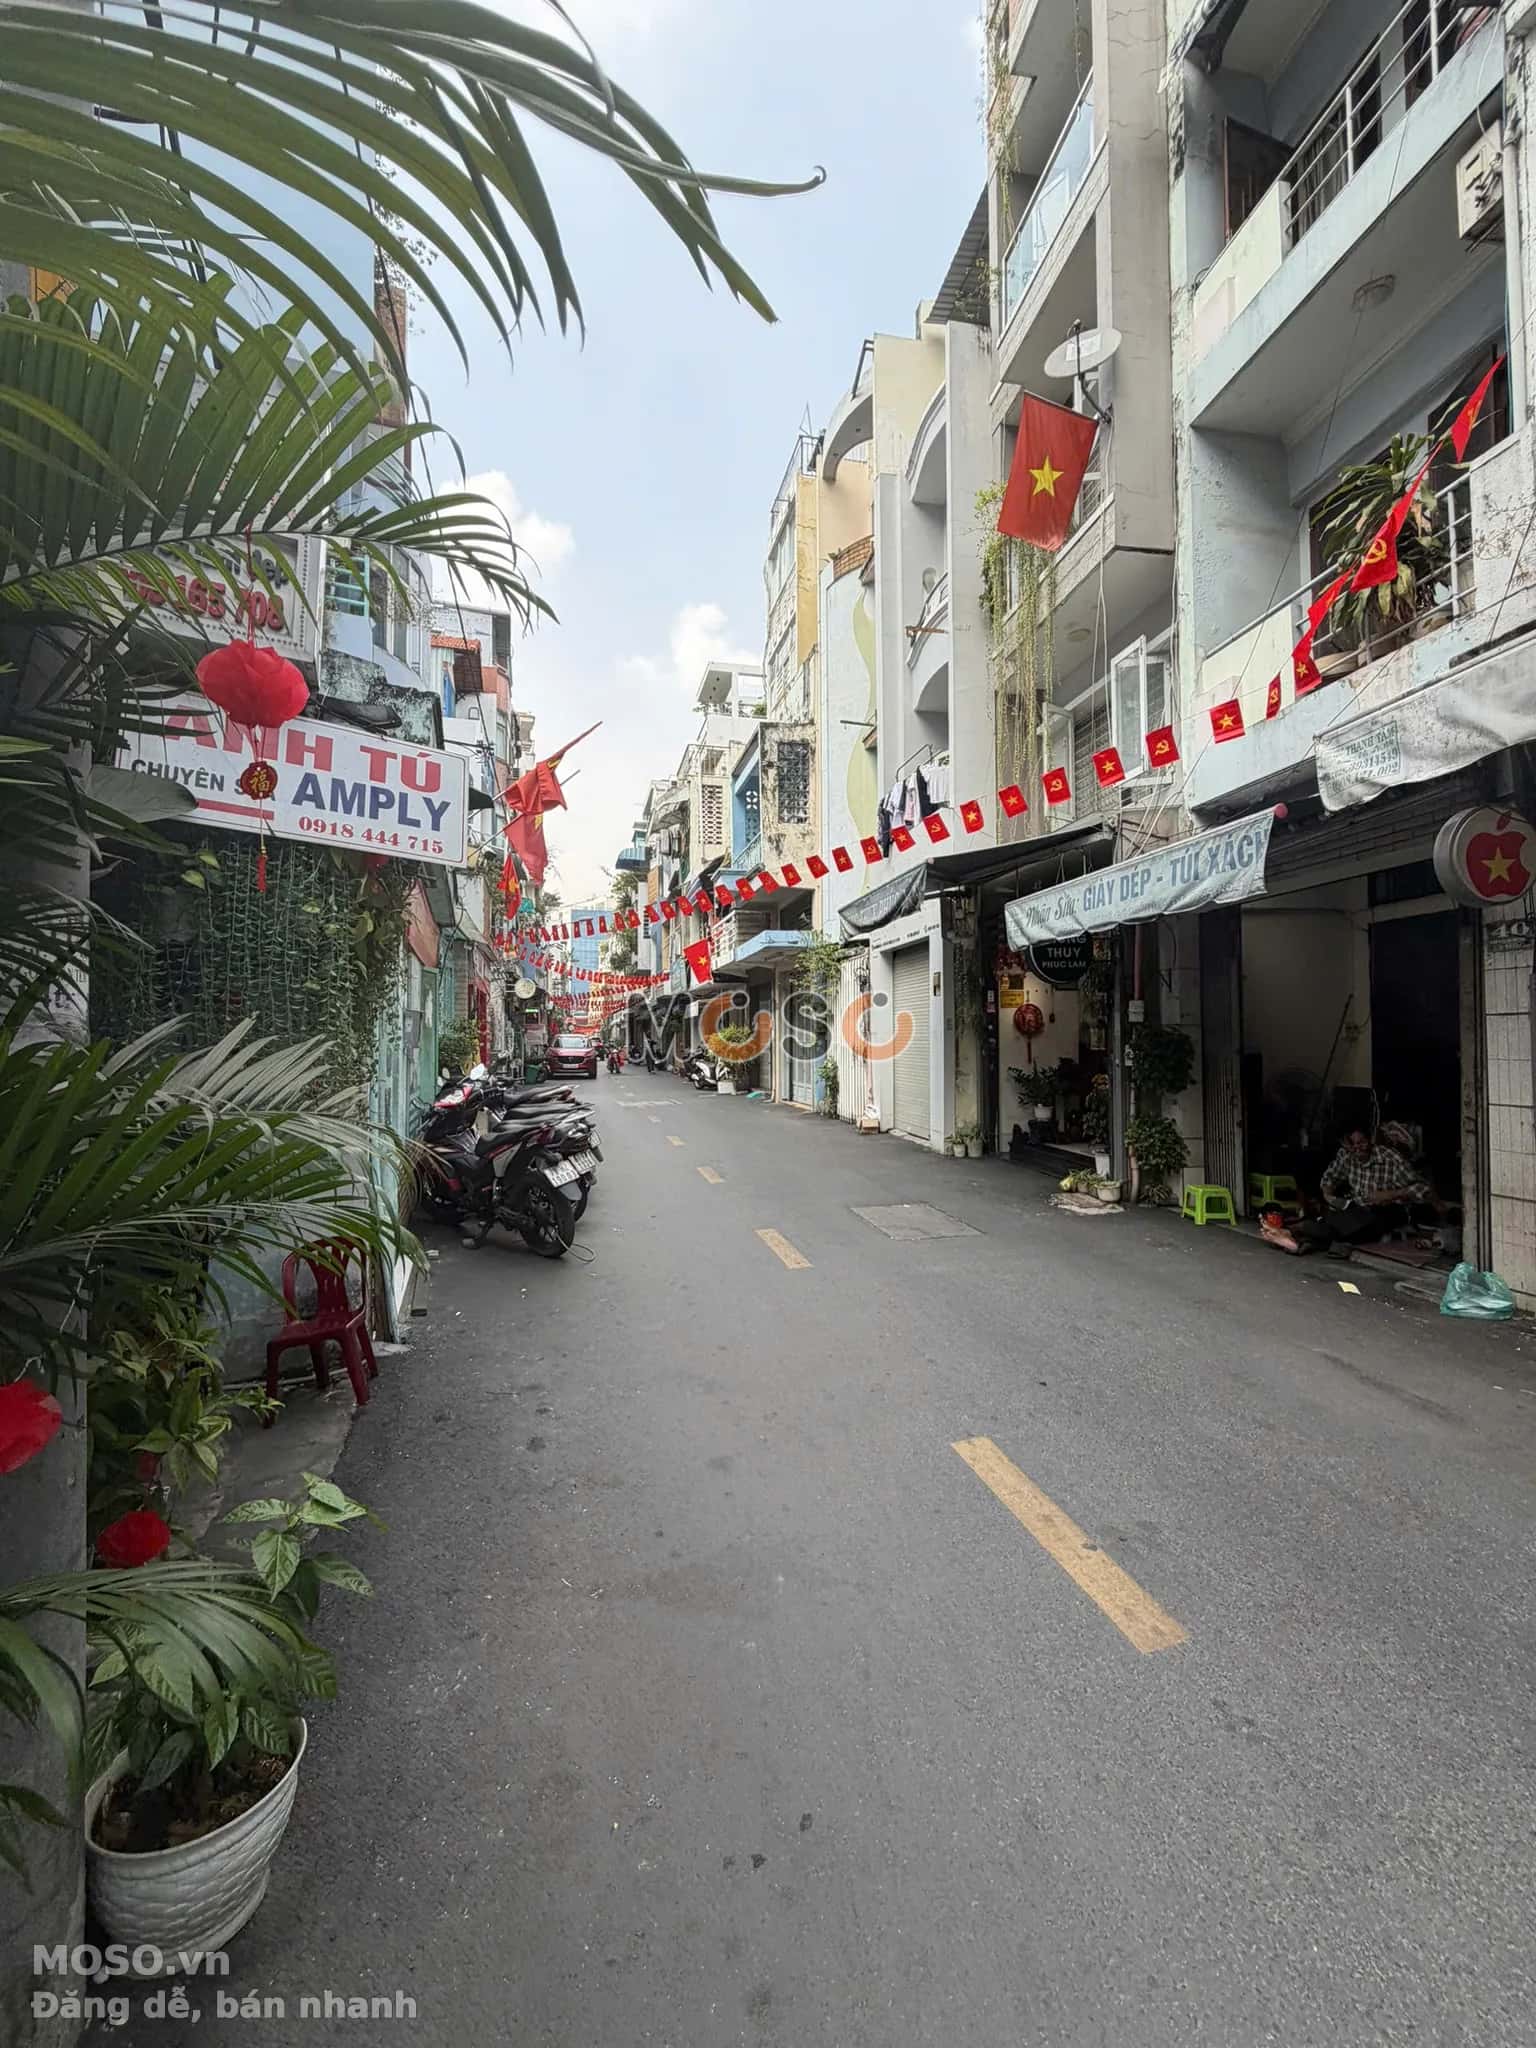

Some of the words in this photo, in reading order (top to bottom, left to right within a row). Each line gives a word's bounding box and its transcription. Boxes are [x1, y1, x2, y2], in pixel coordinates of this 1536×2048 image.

[360, 745, 441, 793] TÚ
[291, 772, 451, 832] AMPLY
[298, 816, 354, 838] 0918
[361, 828, 400, 846] 444
[408, 836, 443, 854] 715
[1120, 865, 1151, 902] DÉP
[1169, 847, 1200, 887] TÚI
